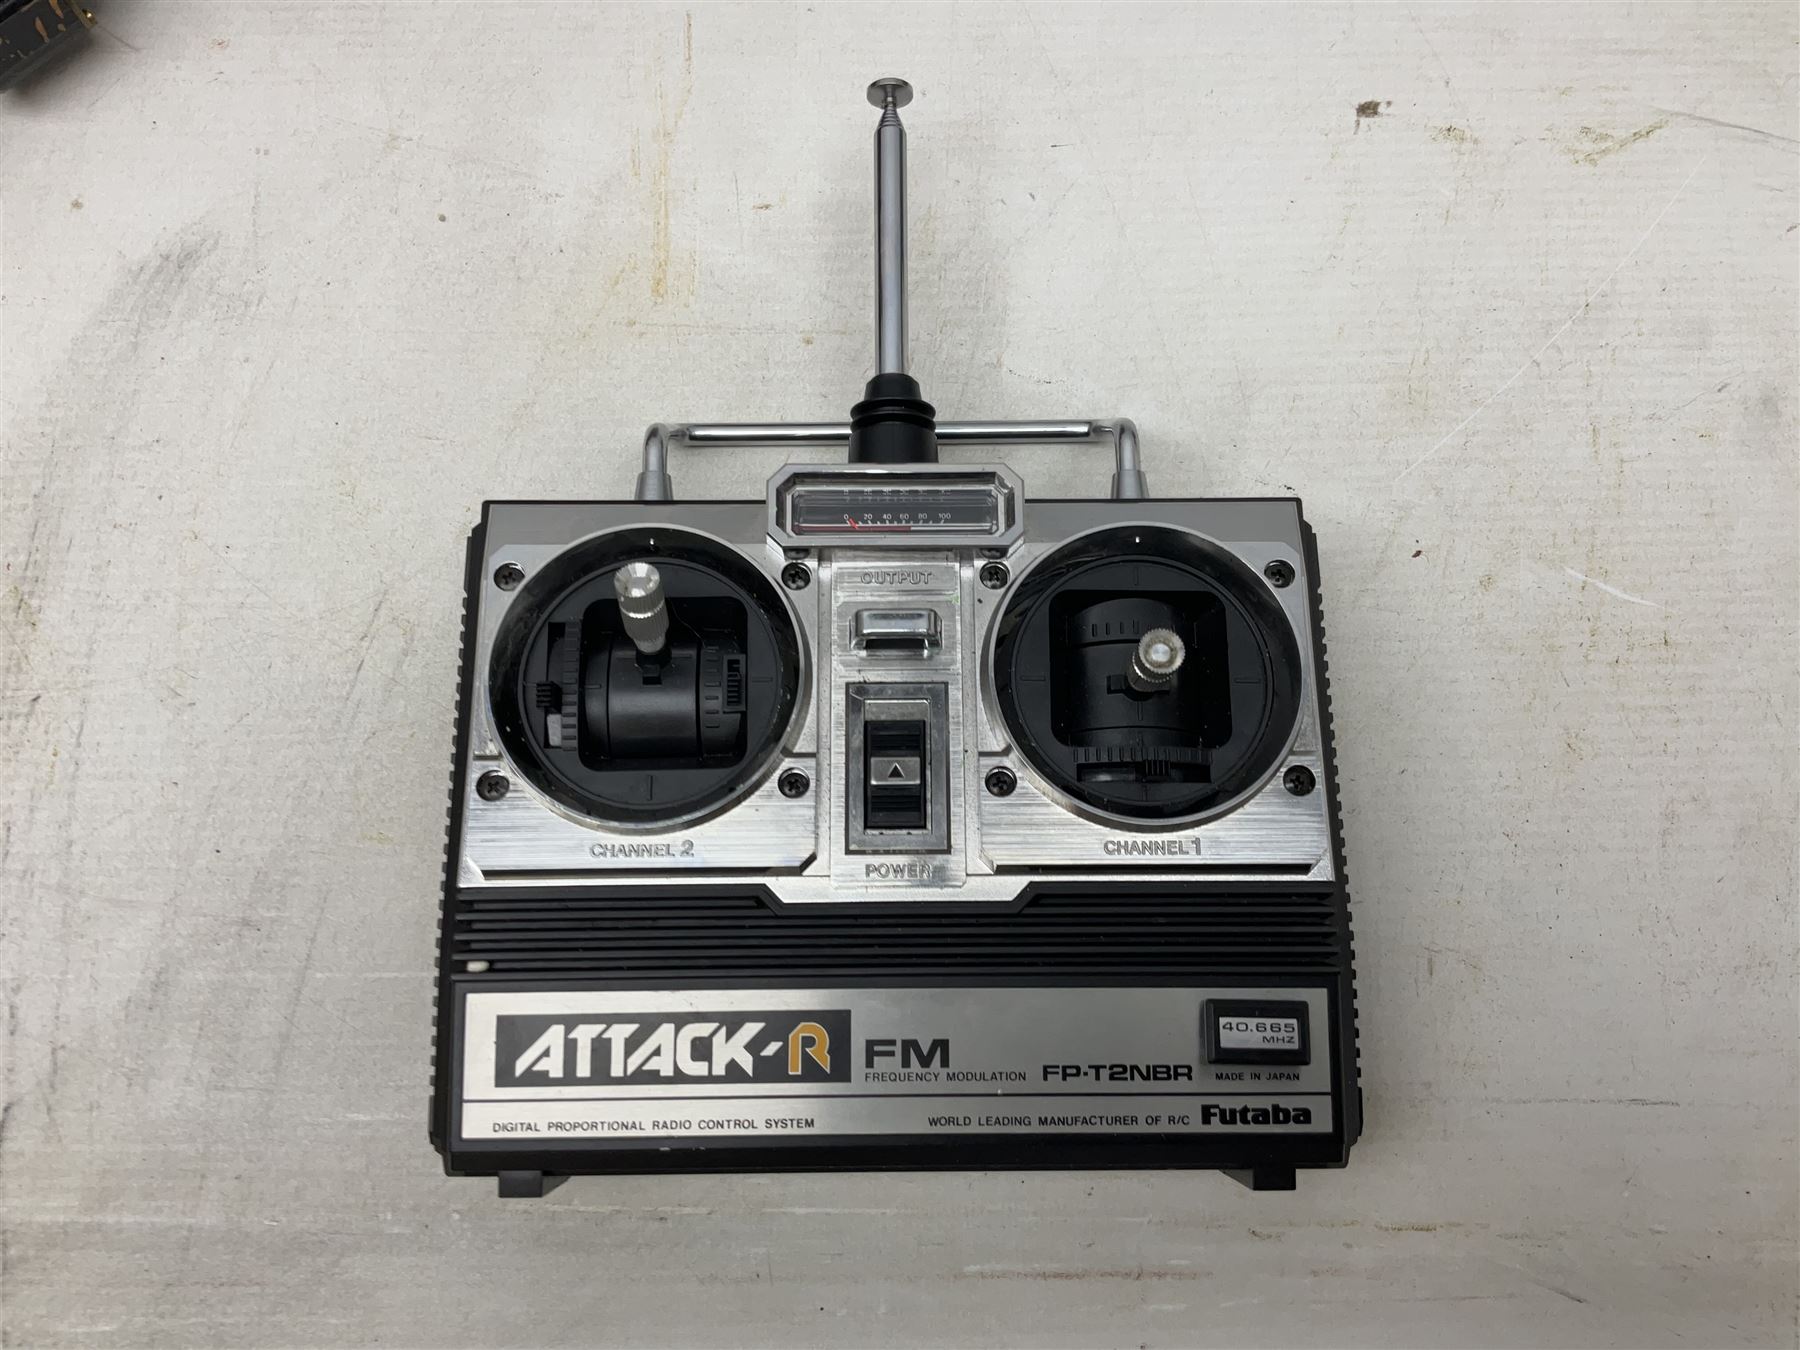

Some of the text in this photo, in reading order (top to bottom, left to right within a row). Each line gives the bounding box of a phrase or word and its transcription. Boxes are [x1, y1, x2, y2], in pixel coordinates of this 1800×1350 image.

[938, 512, 952, 520] 100
[860, 570, 933, 585] OUTPUT
[590, 839, 695, 858] CHANNEL 2
[1103, 837, 1202, 856] CHANNEL 1
[865, 863, 932, 879] POWER
[1222, 1021, 1296, 1033] 40.665
[1262, 1035, 1296, 1044] MHZ
[514, 1021, 831, 1079] ATTACK-R
[864, 1038, 950, 1069] FM
[864, 1071, 1027, 1082] FREQUENCY MODULATION
[1042, 1063, 1193, 1082] FP-T2NBR
[1215, 1072, 1301, 1081] MADE IN JAPAN
[928, 1115, 1190, 1127] WORLD LEADING MANUFACTURER OF R/C
[1201, 1103, 1312, 1126] Futaba
[492, 1118, 816, 1133] DIGITAL PROPORTIONAL RADIO CONTROL SYSTEM
